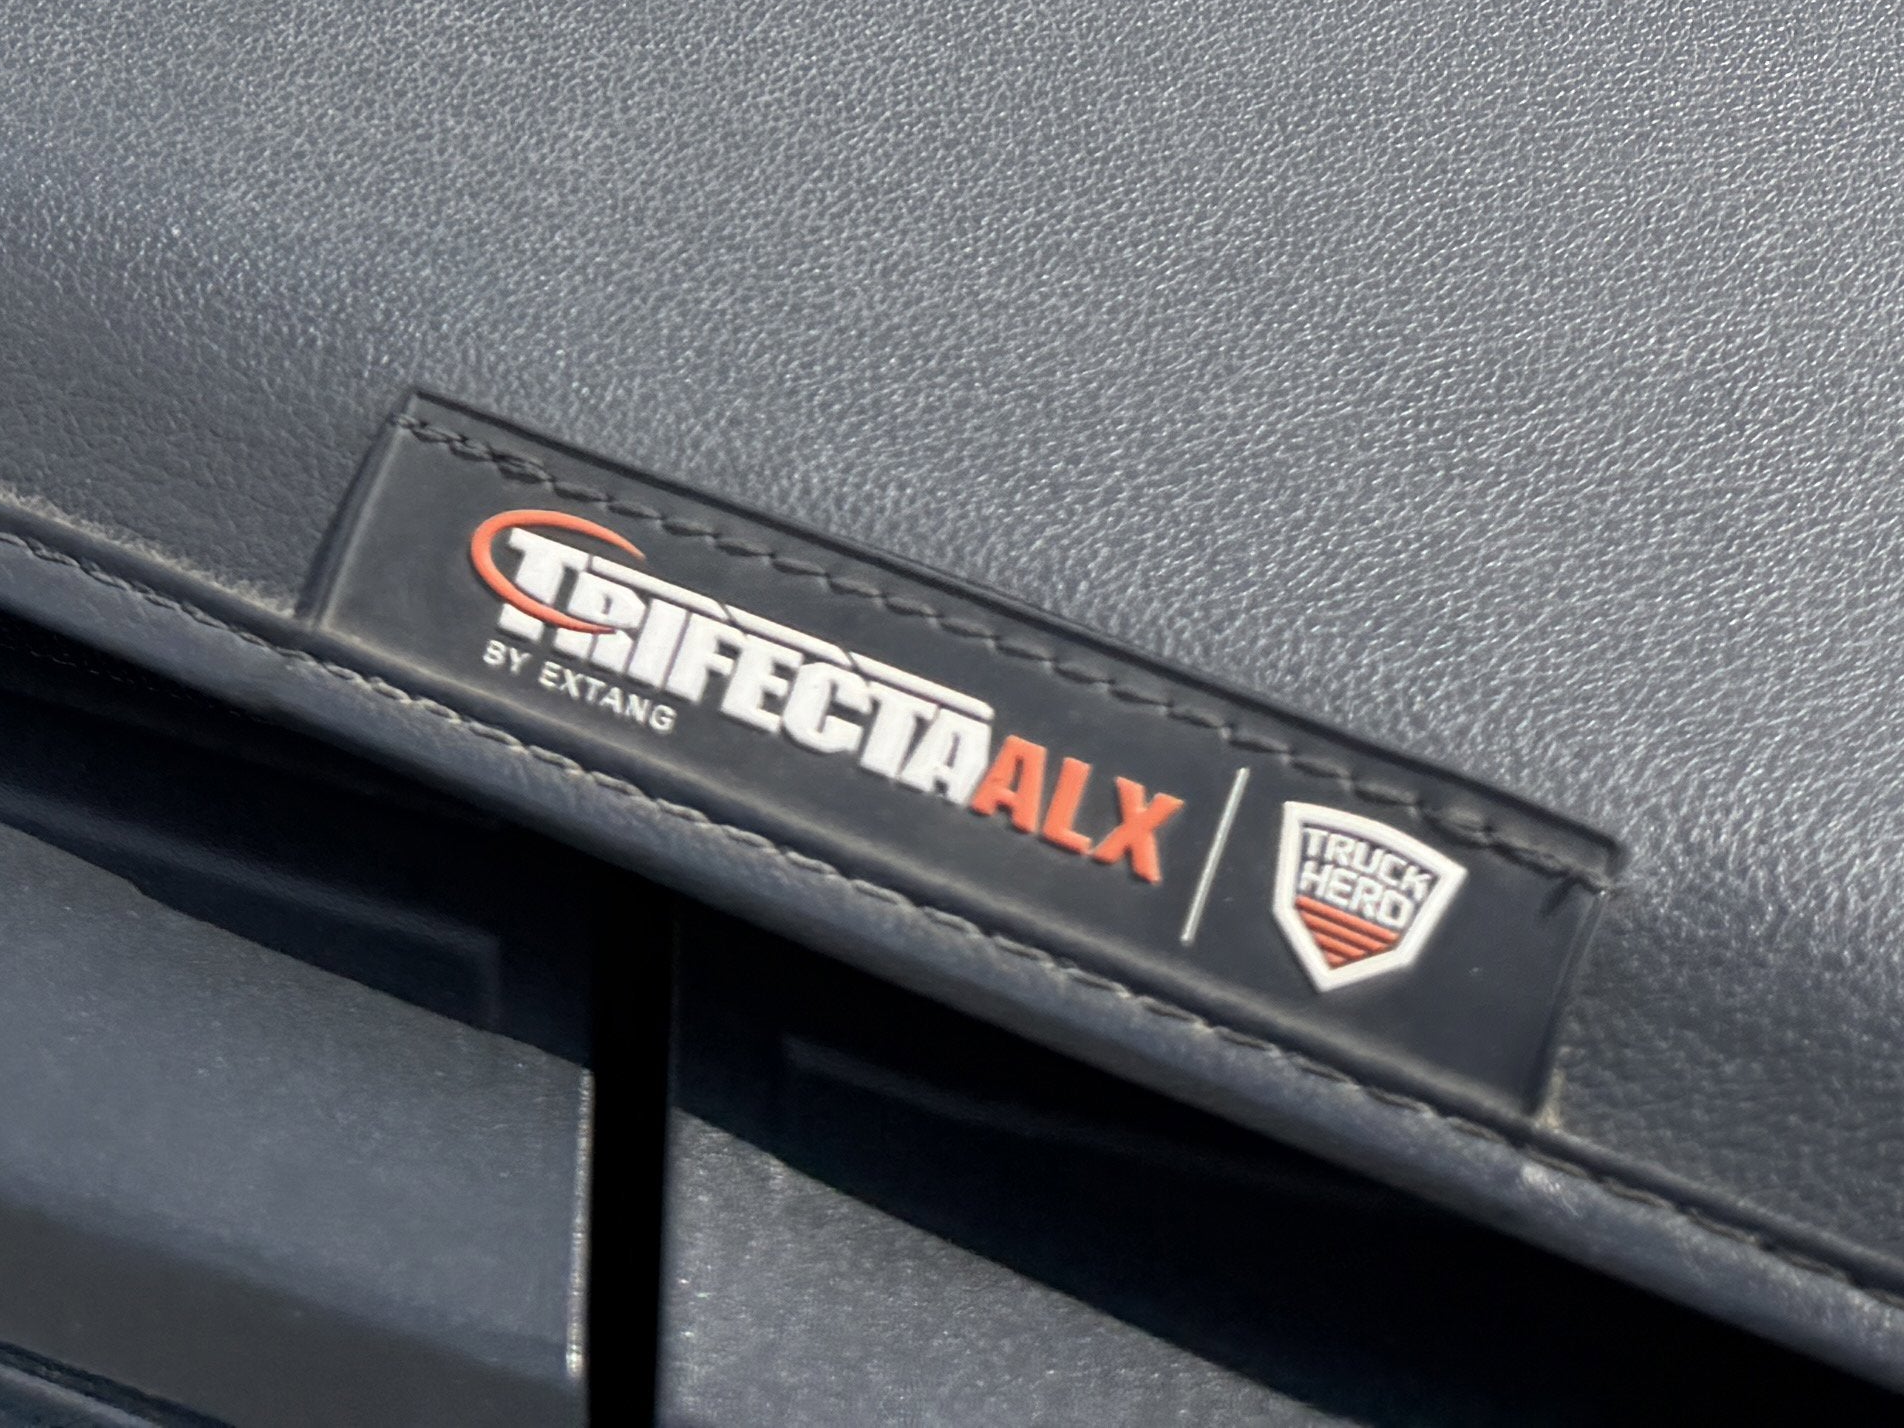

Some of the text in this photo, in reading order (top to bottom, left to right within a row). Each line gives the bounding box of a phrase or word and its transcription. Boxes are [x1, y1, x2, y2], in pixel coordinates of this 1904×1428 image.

[482, 639, 678, 733] BY EXTANG
[497, 526, 1185, 886] TRIFECTA ALX
[1298, 860, 1415, 929] HERO
[1302, 828, 1432, 900] TRUCK
